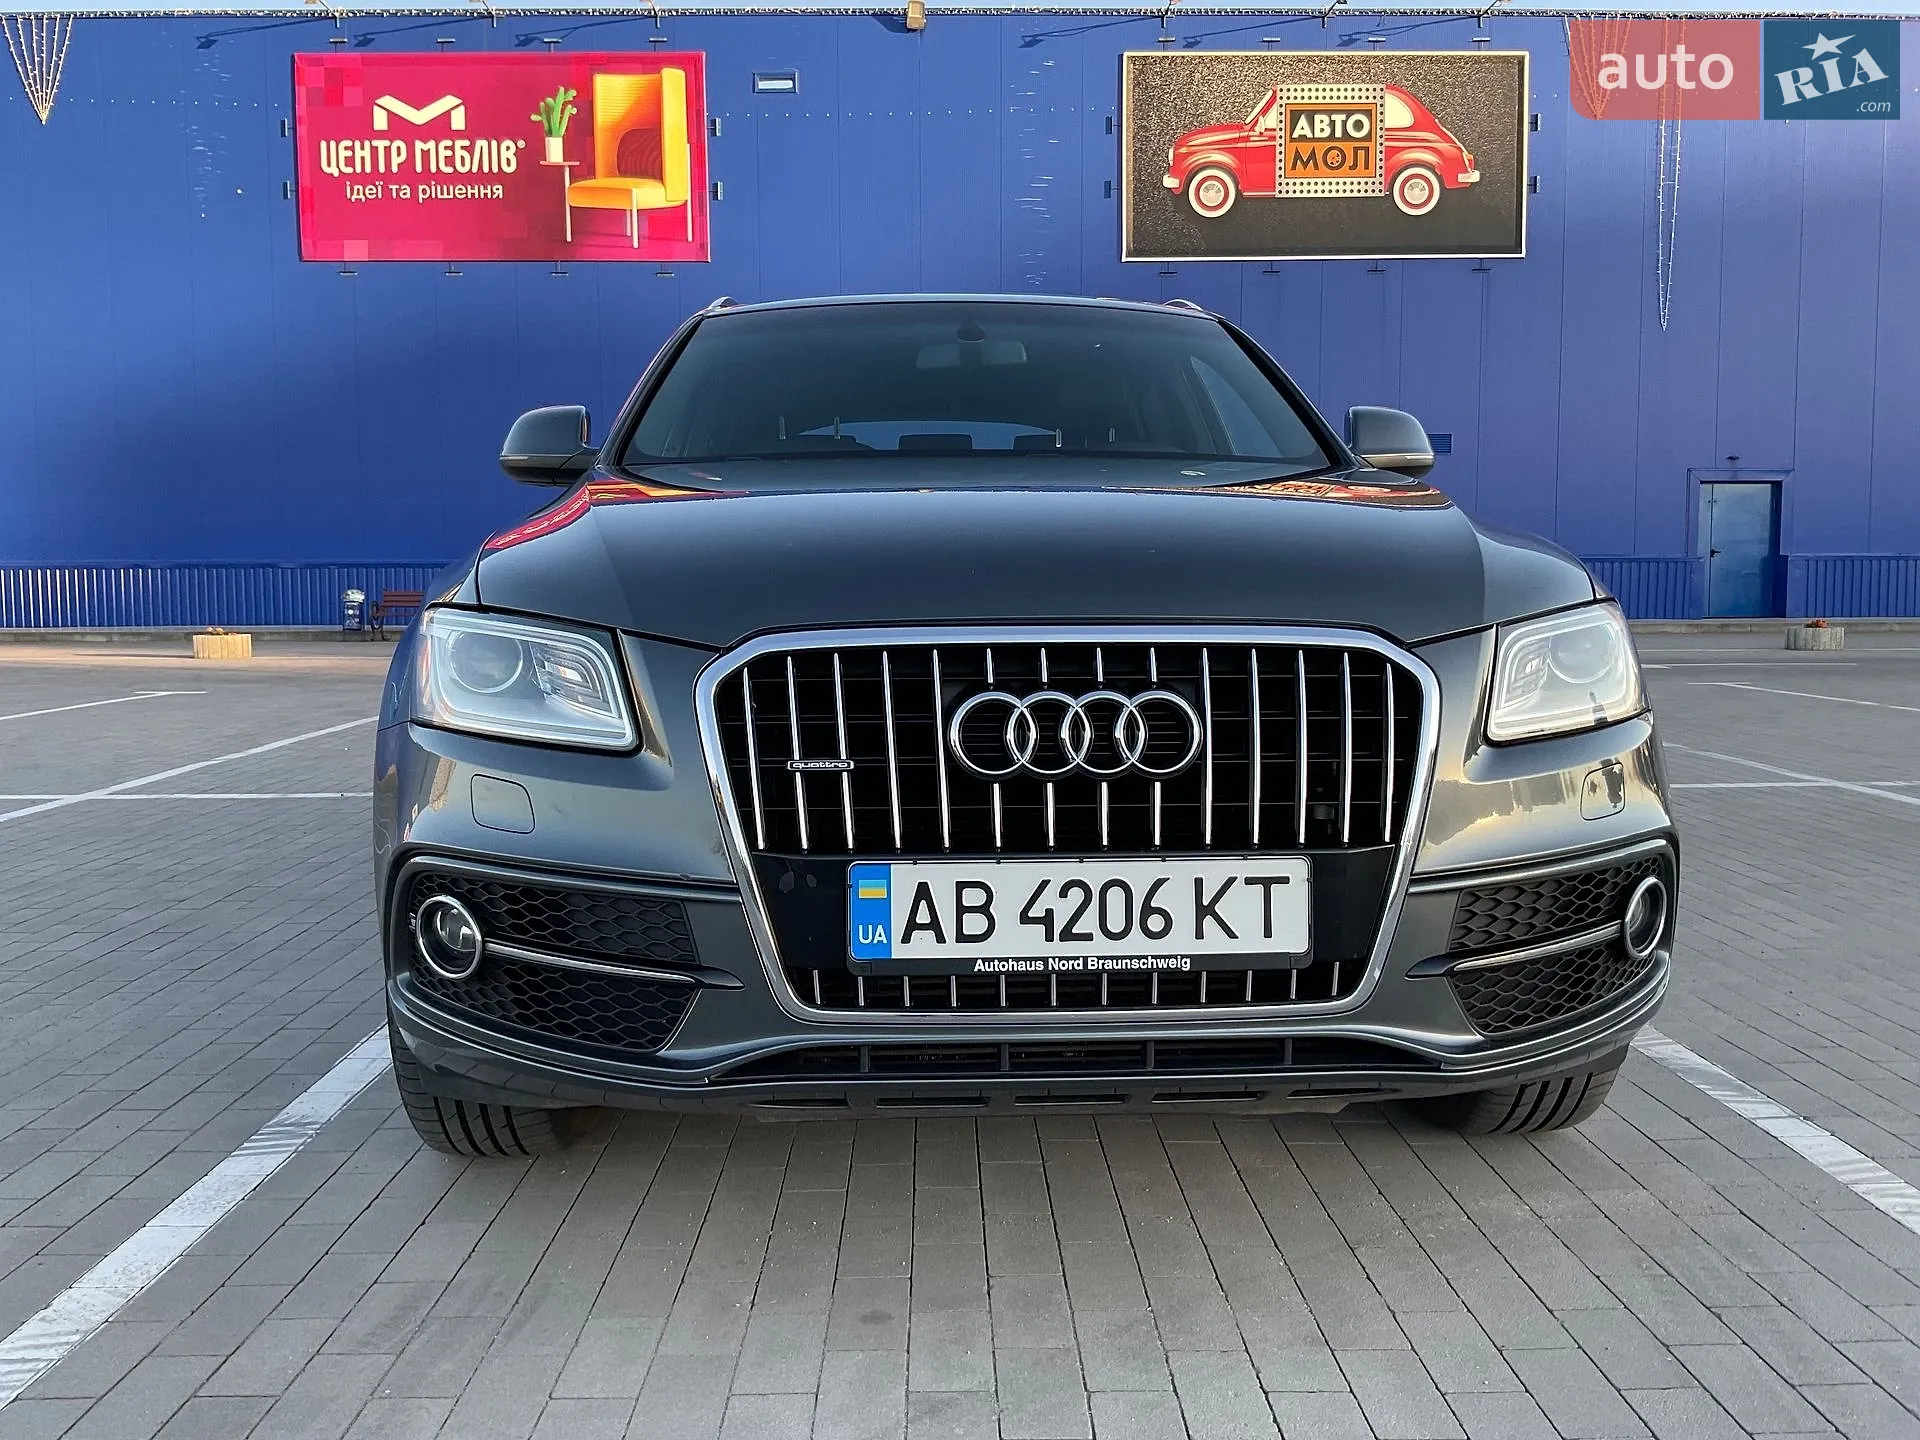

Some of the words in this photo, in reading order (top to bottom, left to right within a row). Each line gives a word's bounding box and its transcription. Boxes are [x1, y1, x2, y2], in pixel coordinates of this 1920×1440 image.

[1291, 114, 1370, 139] АВТО
[319, 139, 408, 178] ЦЕНТР
[1290, 145, 1370, 171] МОЛ
[346, 181, 384, 202] ідеї
[388, 184, 411, 199] та
[418, 181, 504, 203] рішення
[900, 880, 997, 944] AB
[1018, 877, 1174, 943] 4206
[1193, 875, 1291, 940] KT
[858, 924, 888, 944] UA
[973, 958, 1044, 972] Autohaus
[1048, 957, 1084, 971] Nord
[1087, 955, 1191, 971] Braunschweig
